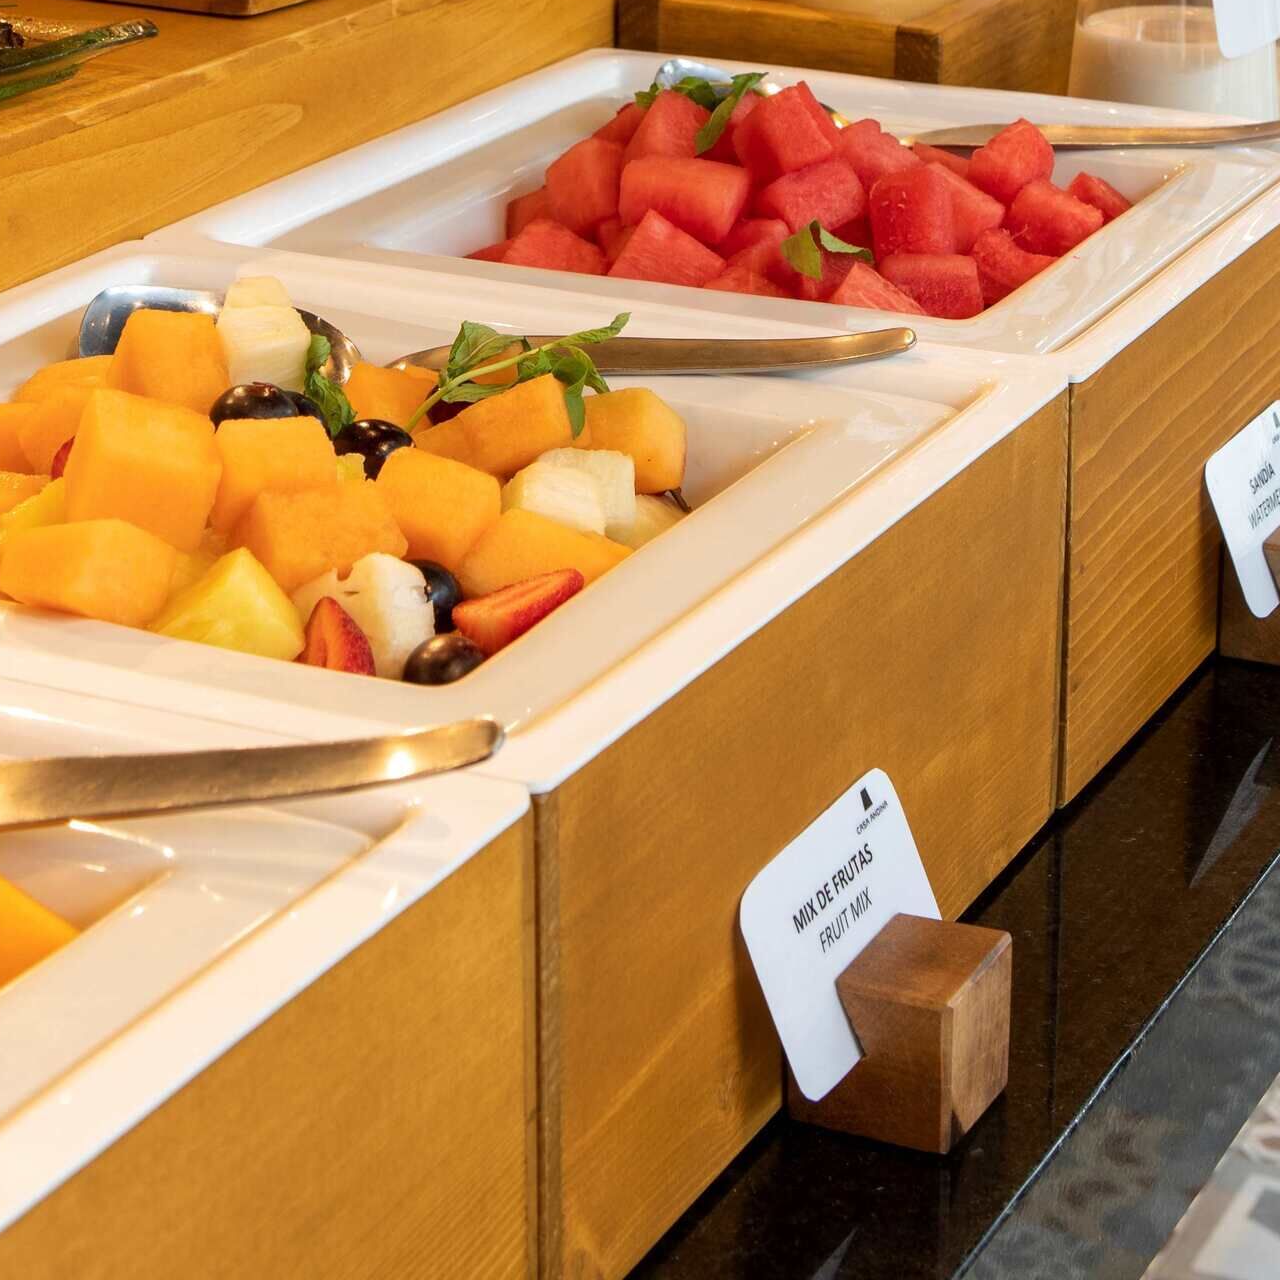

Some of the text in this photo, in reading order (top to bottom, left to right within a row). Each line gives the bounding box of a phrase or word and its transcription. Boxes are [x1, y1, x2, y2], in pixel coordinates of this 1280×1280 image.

[1249, 460, 1276, 495] SANDÍA
[856, 800, 888, 835] CASA ANDINA
[793, 842, 873, 934] MIX DE FRUTAS
[819, 886, 872, 953] FRUIT MIX
